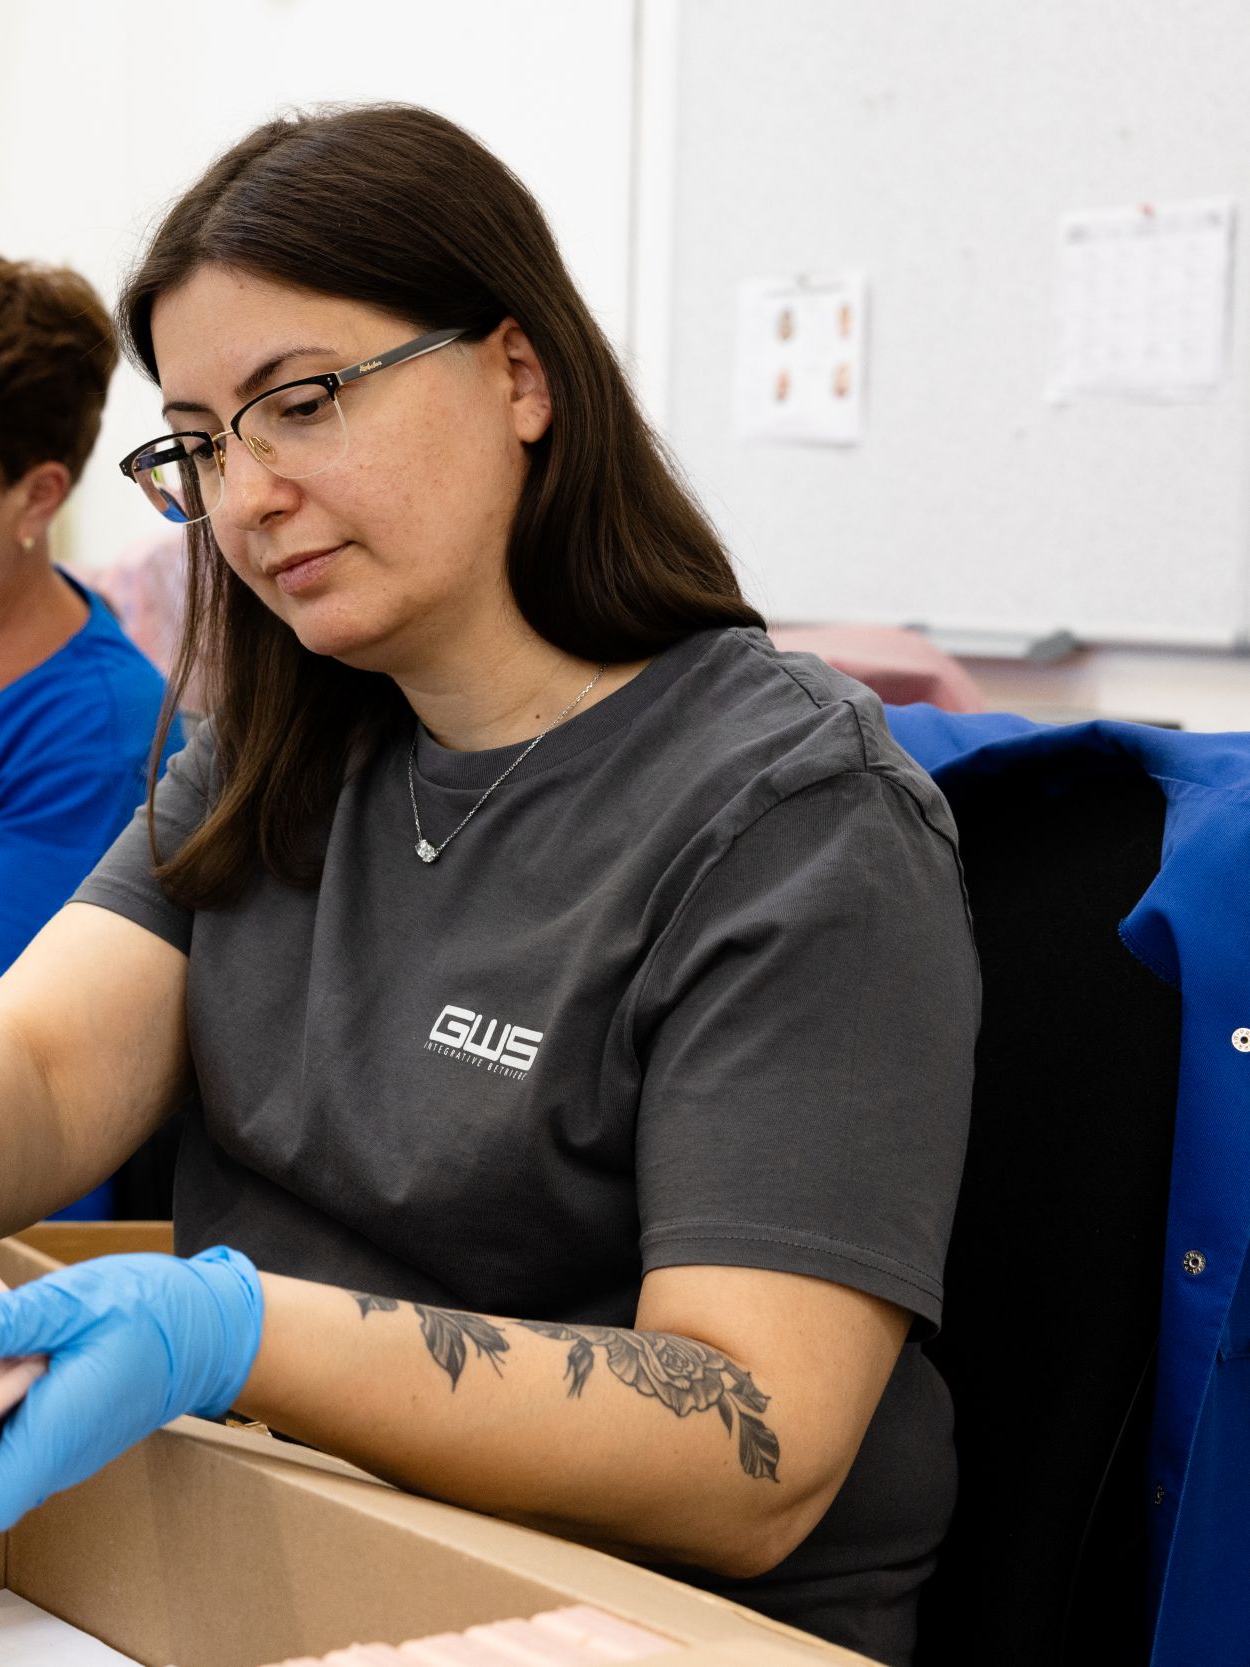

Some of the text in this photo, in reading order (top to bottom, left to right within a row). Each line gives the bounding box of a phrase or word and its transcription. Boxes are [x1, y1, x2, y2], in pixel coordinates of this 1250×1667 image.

[424, 1041, 528, 1081] INTEGRATIVE BETRIEBE
[429, 1005, 543, 1071] GWS
